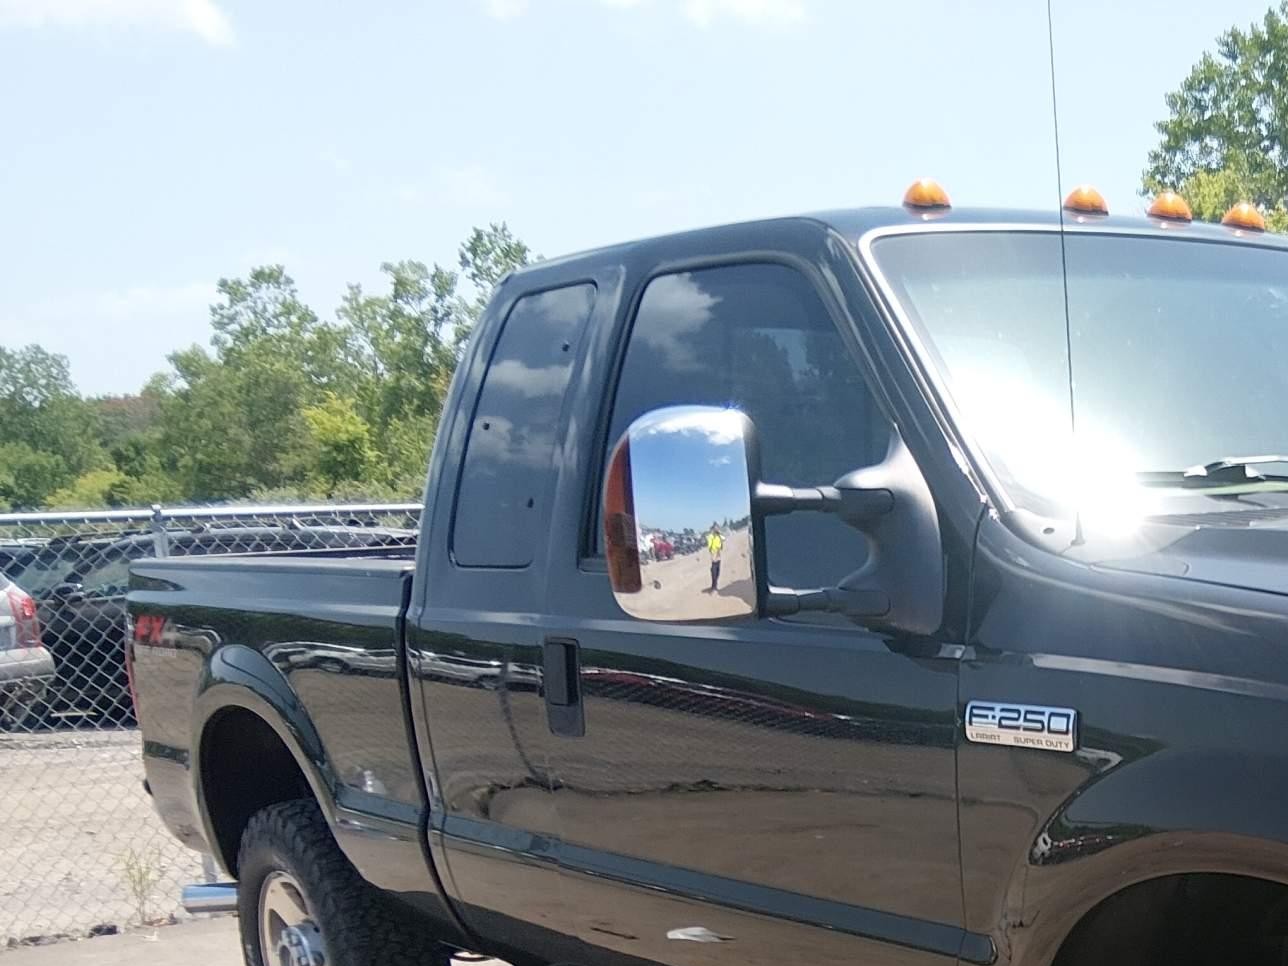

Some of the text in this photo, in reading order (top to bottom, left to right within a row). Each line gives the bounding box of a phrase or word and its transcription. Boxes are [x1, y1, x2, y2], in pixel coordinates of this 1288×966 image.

[968, 704, 1071, 735] F-250
[1013, 736, 1070, 749] SUPER DUTY
